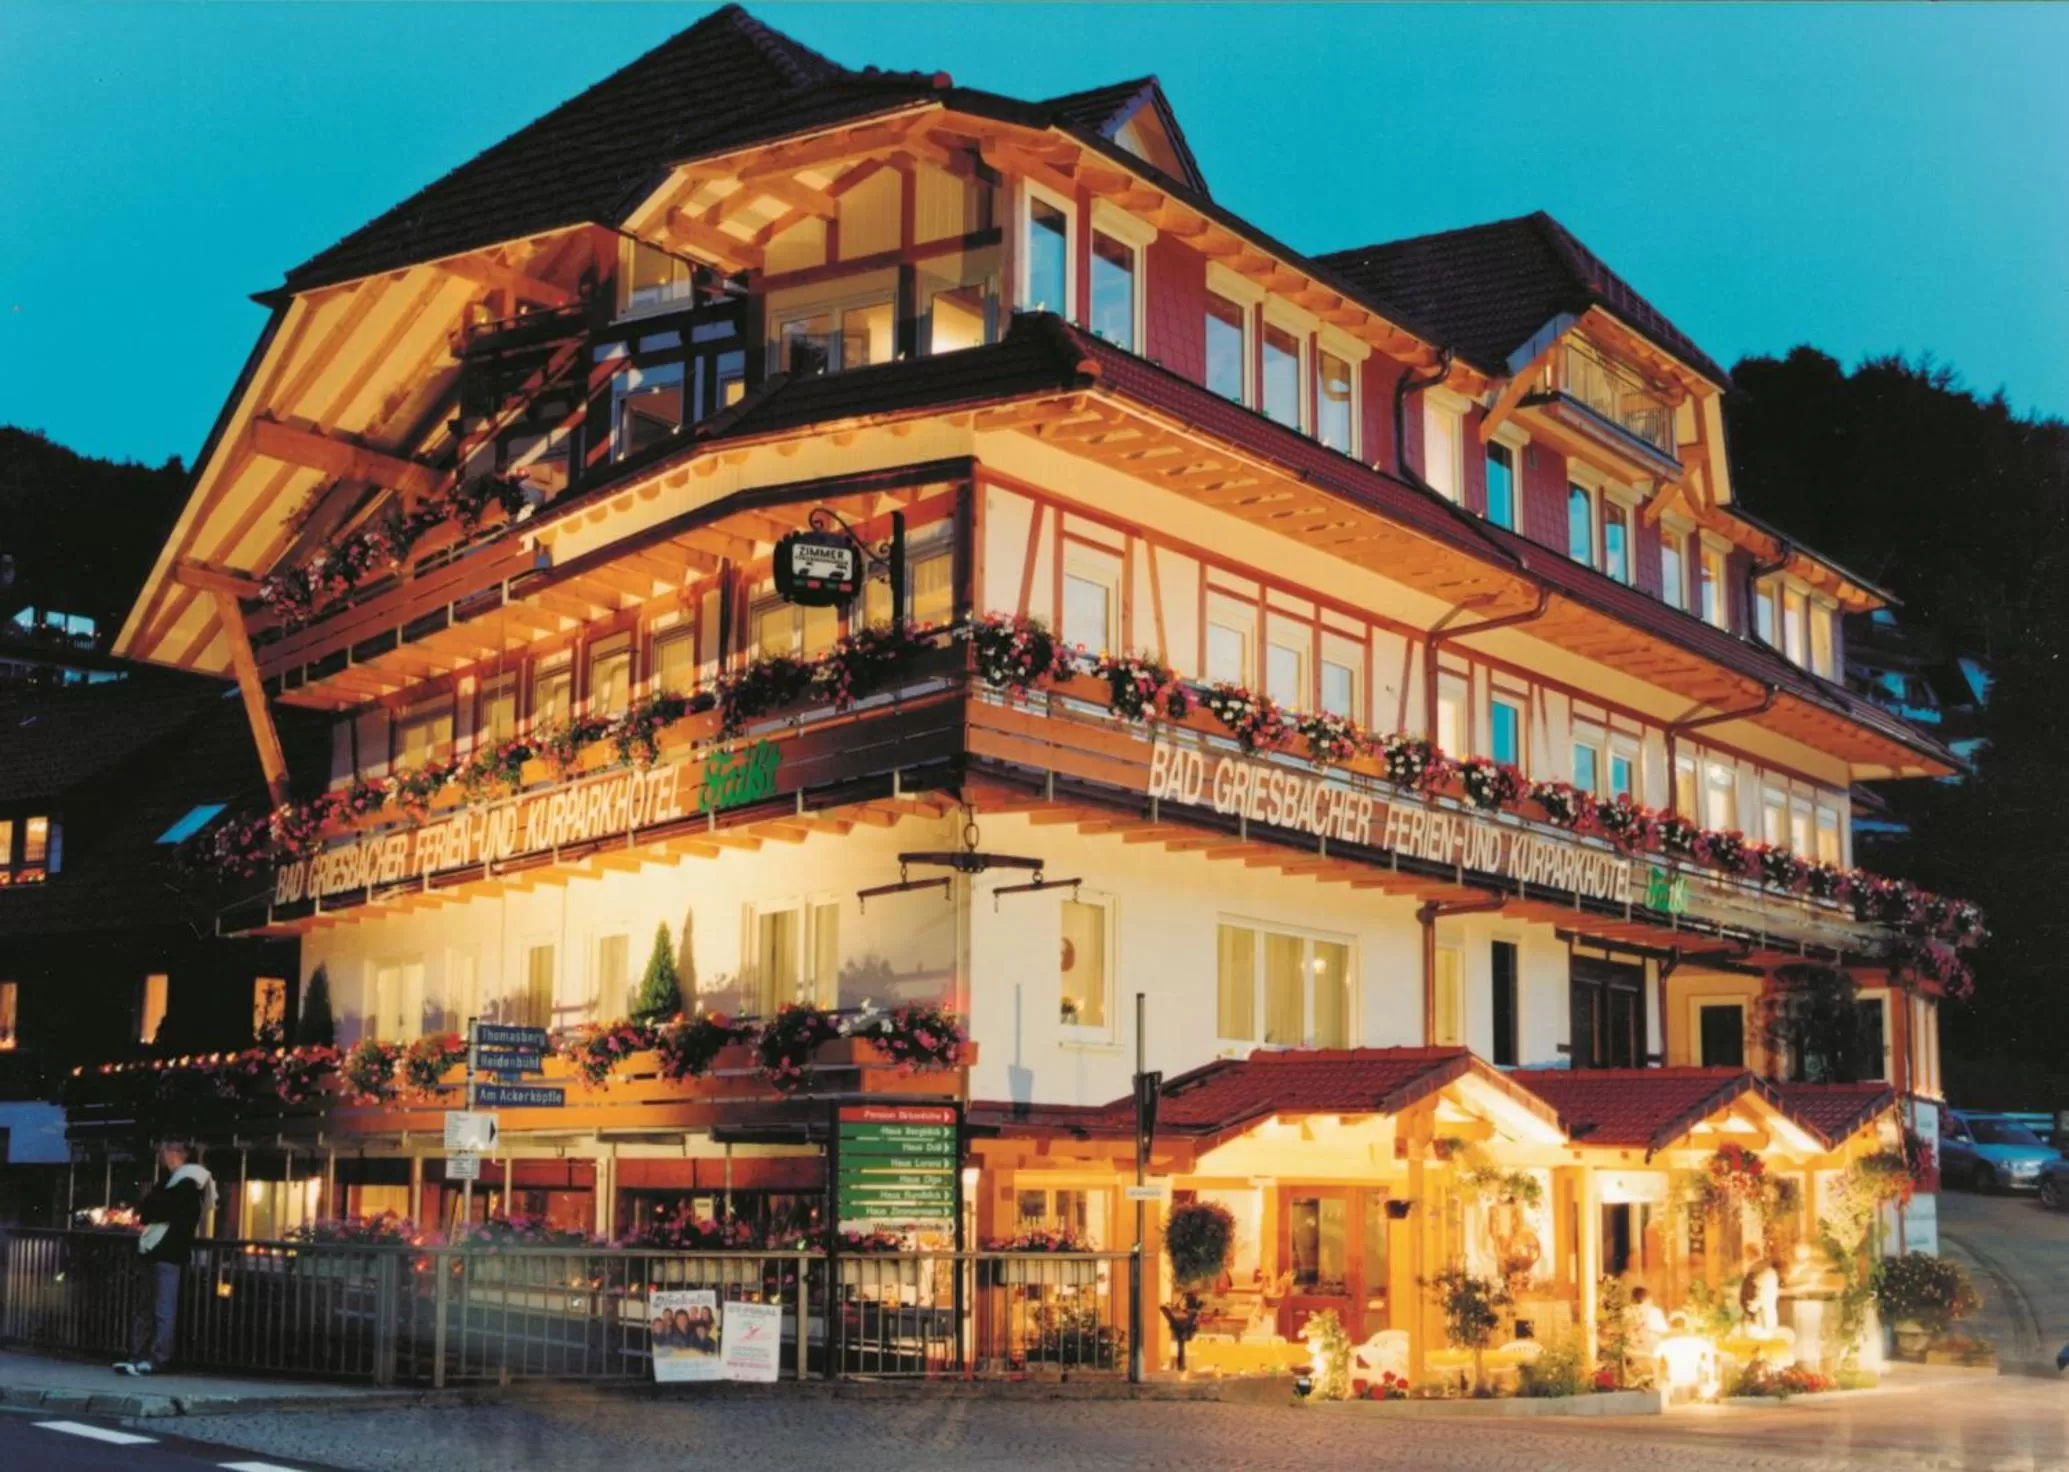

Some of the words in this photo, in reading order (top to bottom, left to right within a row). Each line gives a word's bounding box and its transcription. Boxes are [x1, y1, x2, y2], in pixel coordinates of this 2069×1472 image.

[799, 546, 844, 560] ZIMMER
[1148, 740, 1204, 806] BAD
[1212, 757, 1373, 846] GRIESBACHER
[1508, 831, 1632, 904] KURPARKHOTEL
[275, 861, 305, 906] BAD
[307, 832, 408, 898] GRIESBACHER
[524, 764, 682, 852] KURPARKHOTEL
[482, 1028, 545, 1046] Thomasberg
[480, 1088, 497, 1101] Am
